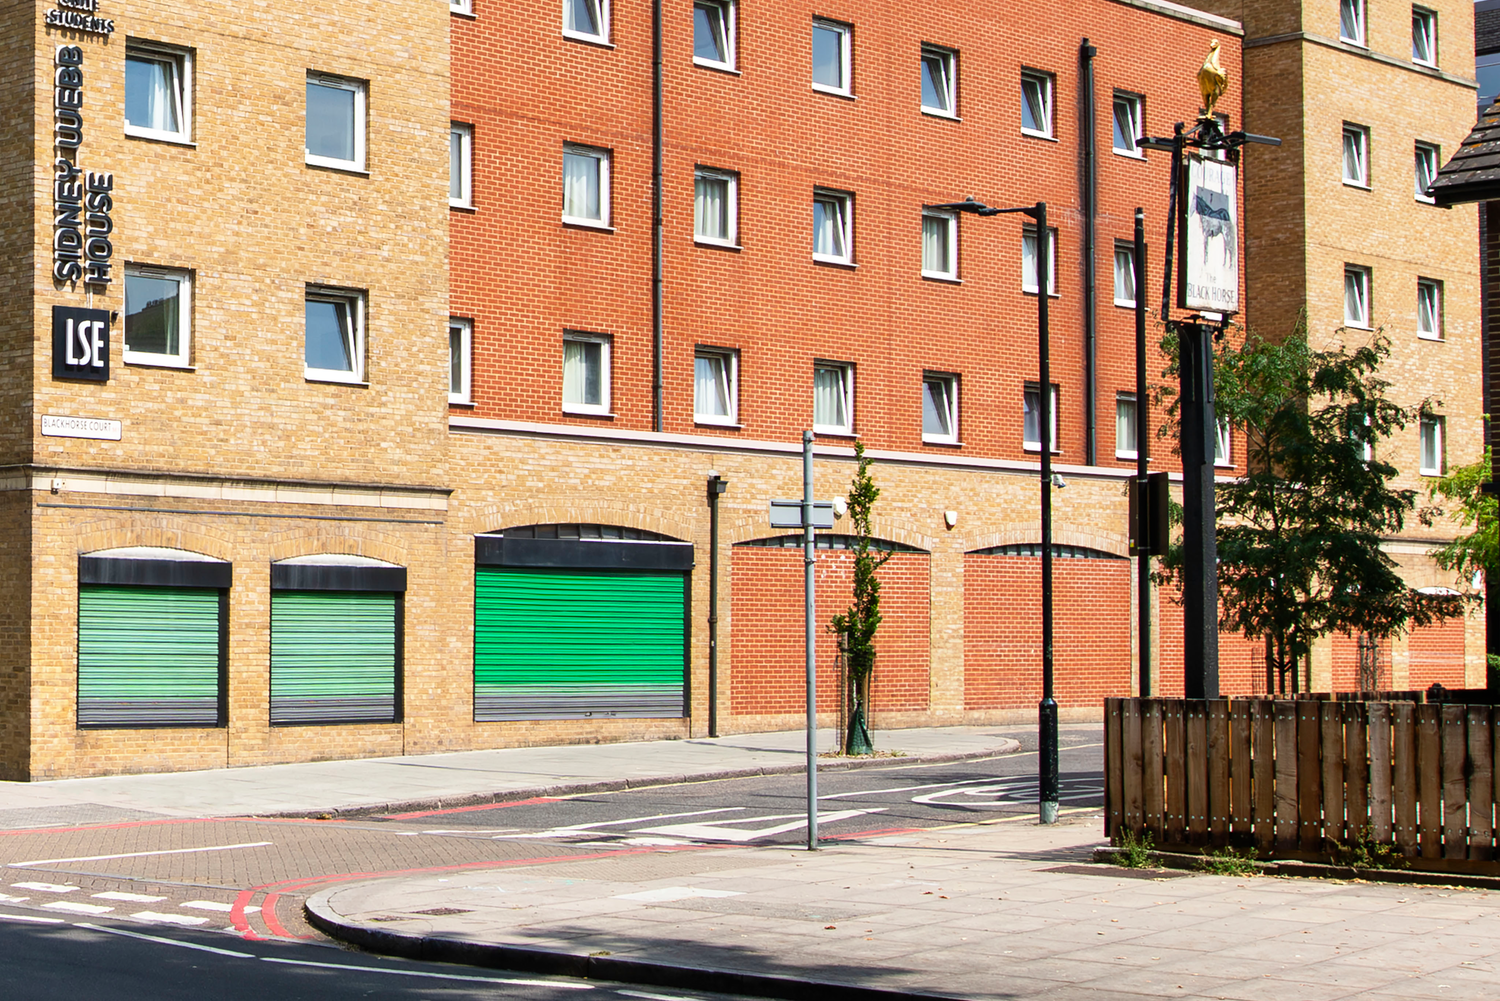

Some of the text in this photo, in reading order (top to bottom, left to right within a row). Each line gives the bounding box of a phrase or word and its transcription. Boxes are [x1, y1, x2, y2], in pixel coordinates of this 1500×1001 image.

[45, 8, 115, 35] STUDENTS
[54, 44, 83, 282] SIDNEY WEBB
[85, 170, 113, 285] HOUSE
[1205, 272, 1217, 283] The
[1188, 282, 1235, 303] BLACK HORSE
[65, 318, 105, 367] LSE
[43, 418, 87, 430] BLACKHORSE
[89, 421, 111, 432] COURT
